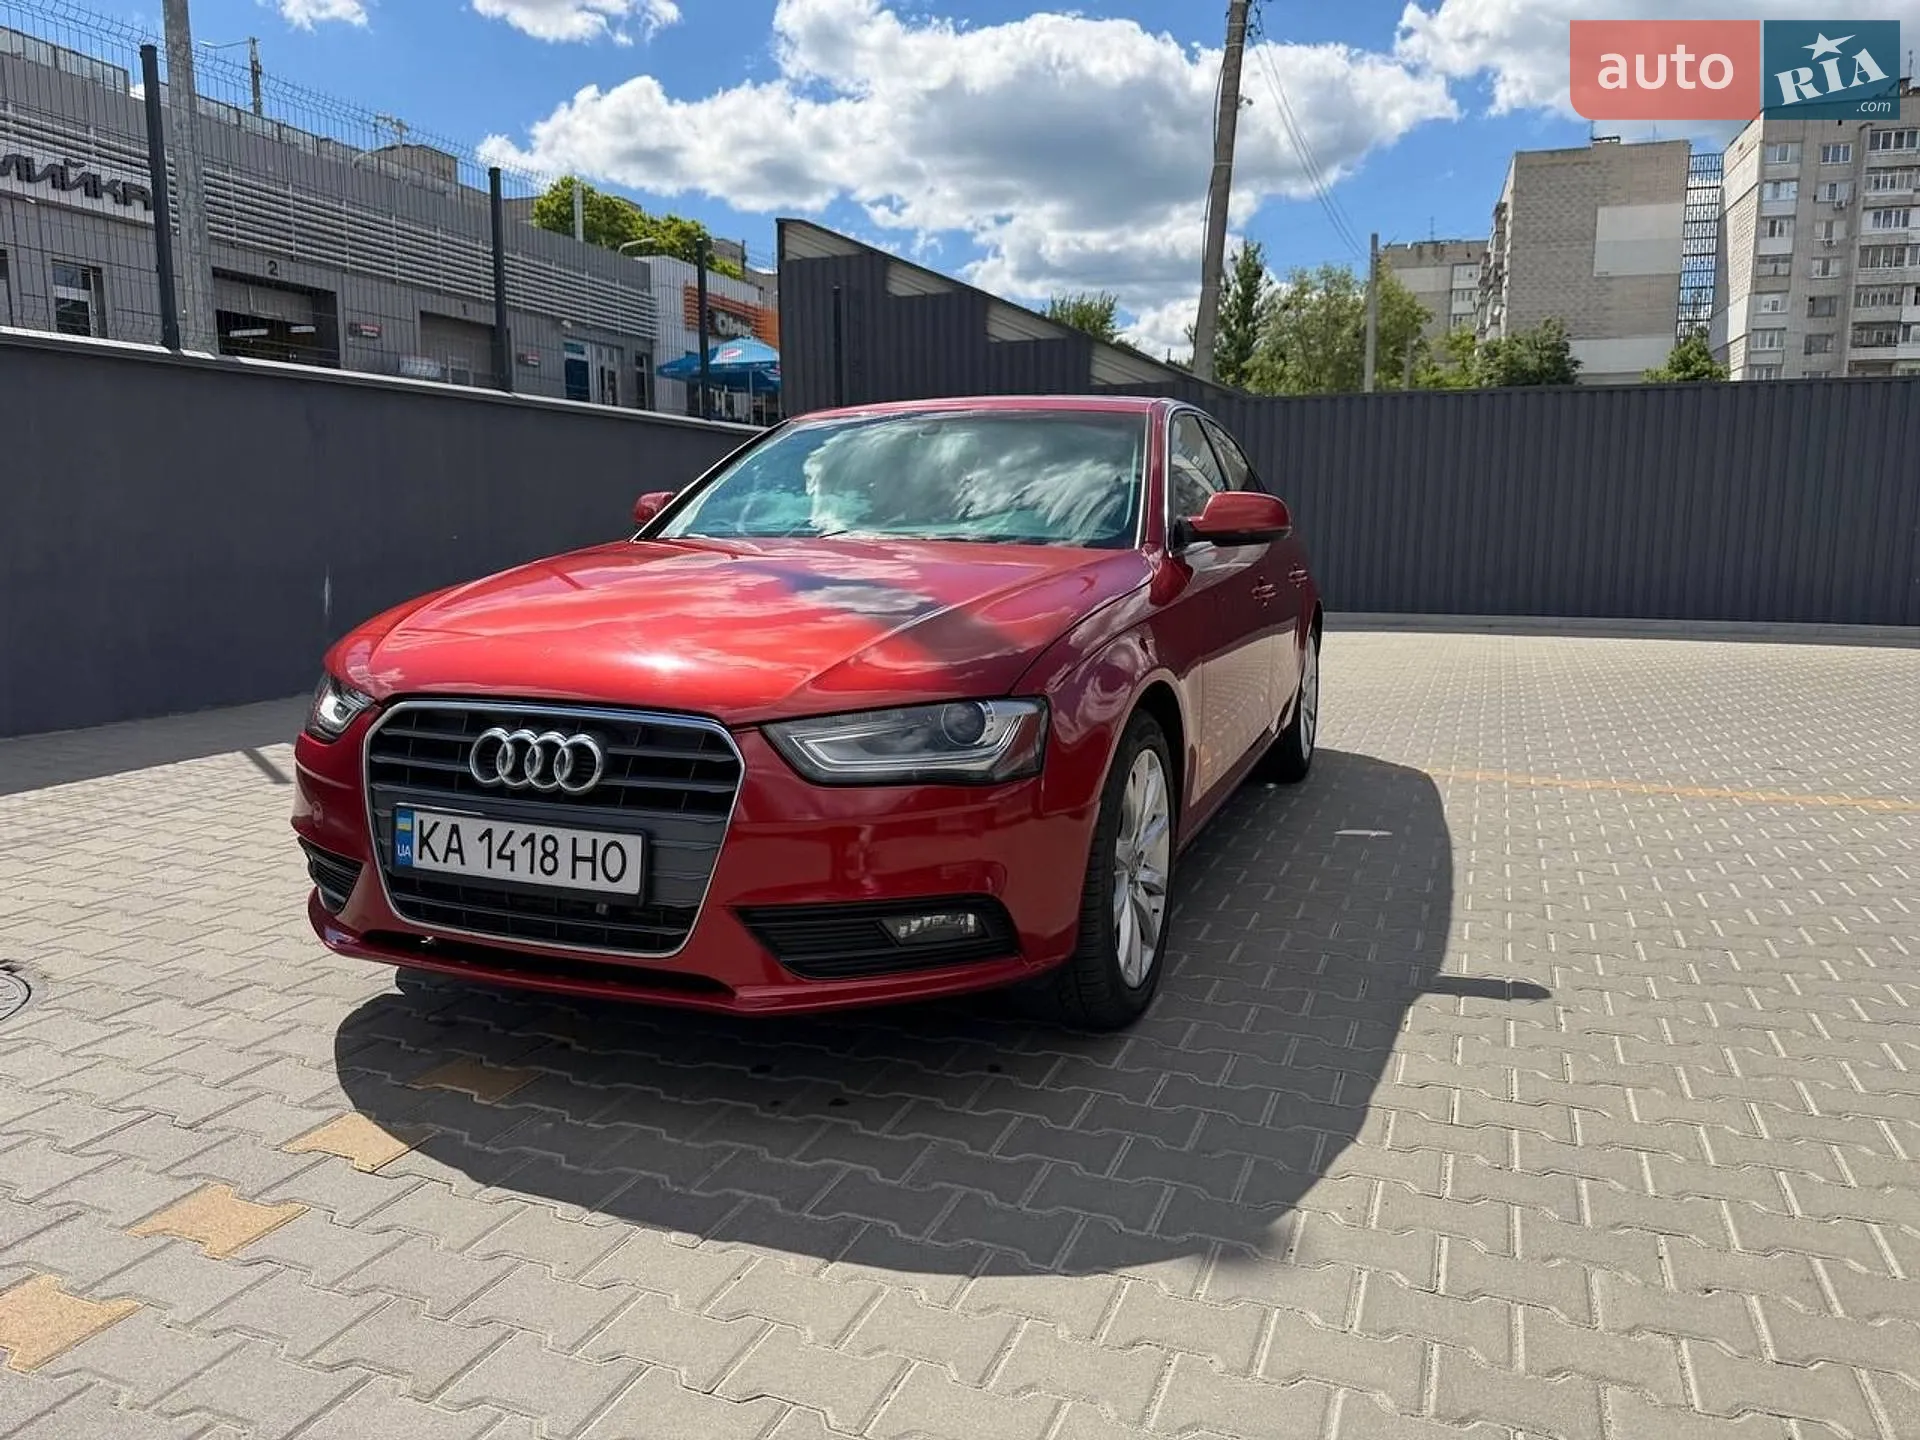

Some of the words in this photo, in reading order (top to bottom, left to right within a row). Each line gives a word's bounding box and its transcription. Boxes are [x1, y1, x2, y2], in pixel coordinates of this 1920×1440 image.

[267, 260, 279, 276] 2
[397, 843, 412, 858] UA
[418, 819, 466, 866] KA
[478, 827, 559, 876] 1418
[570, 836, 627, 883] HO
